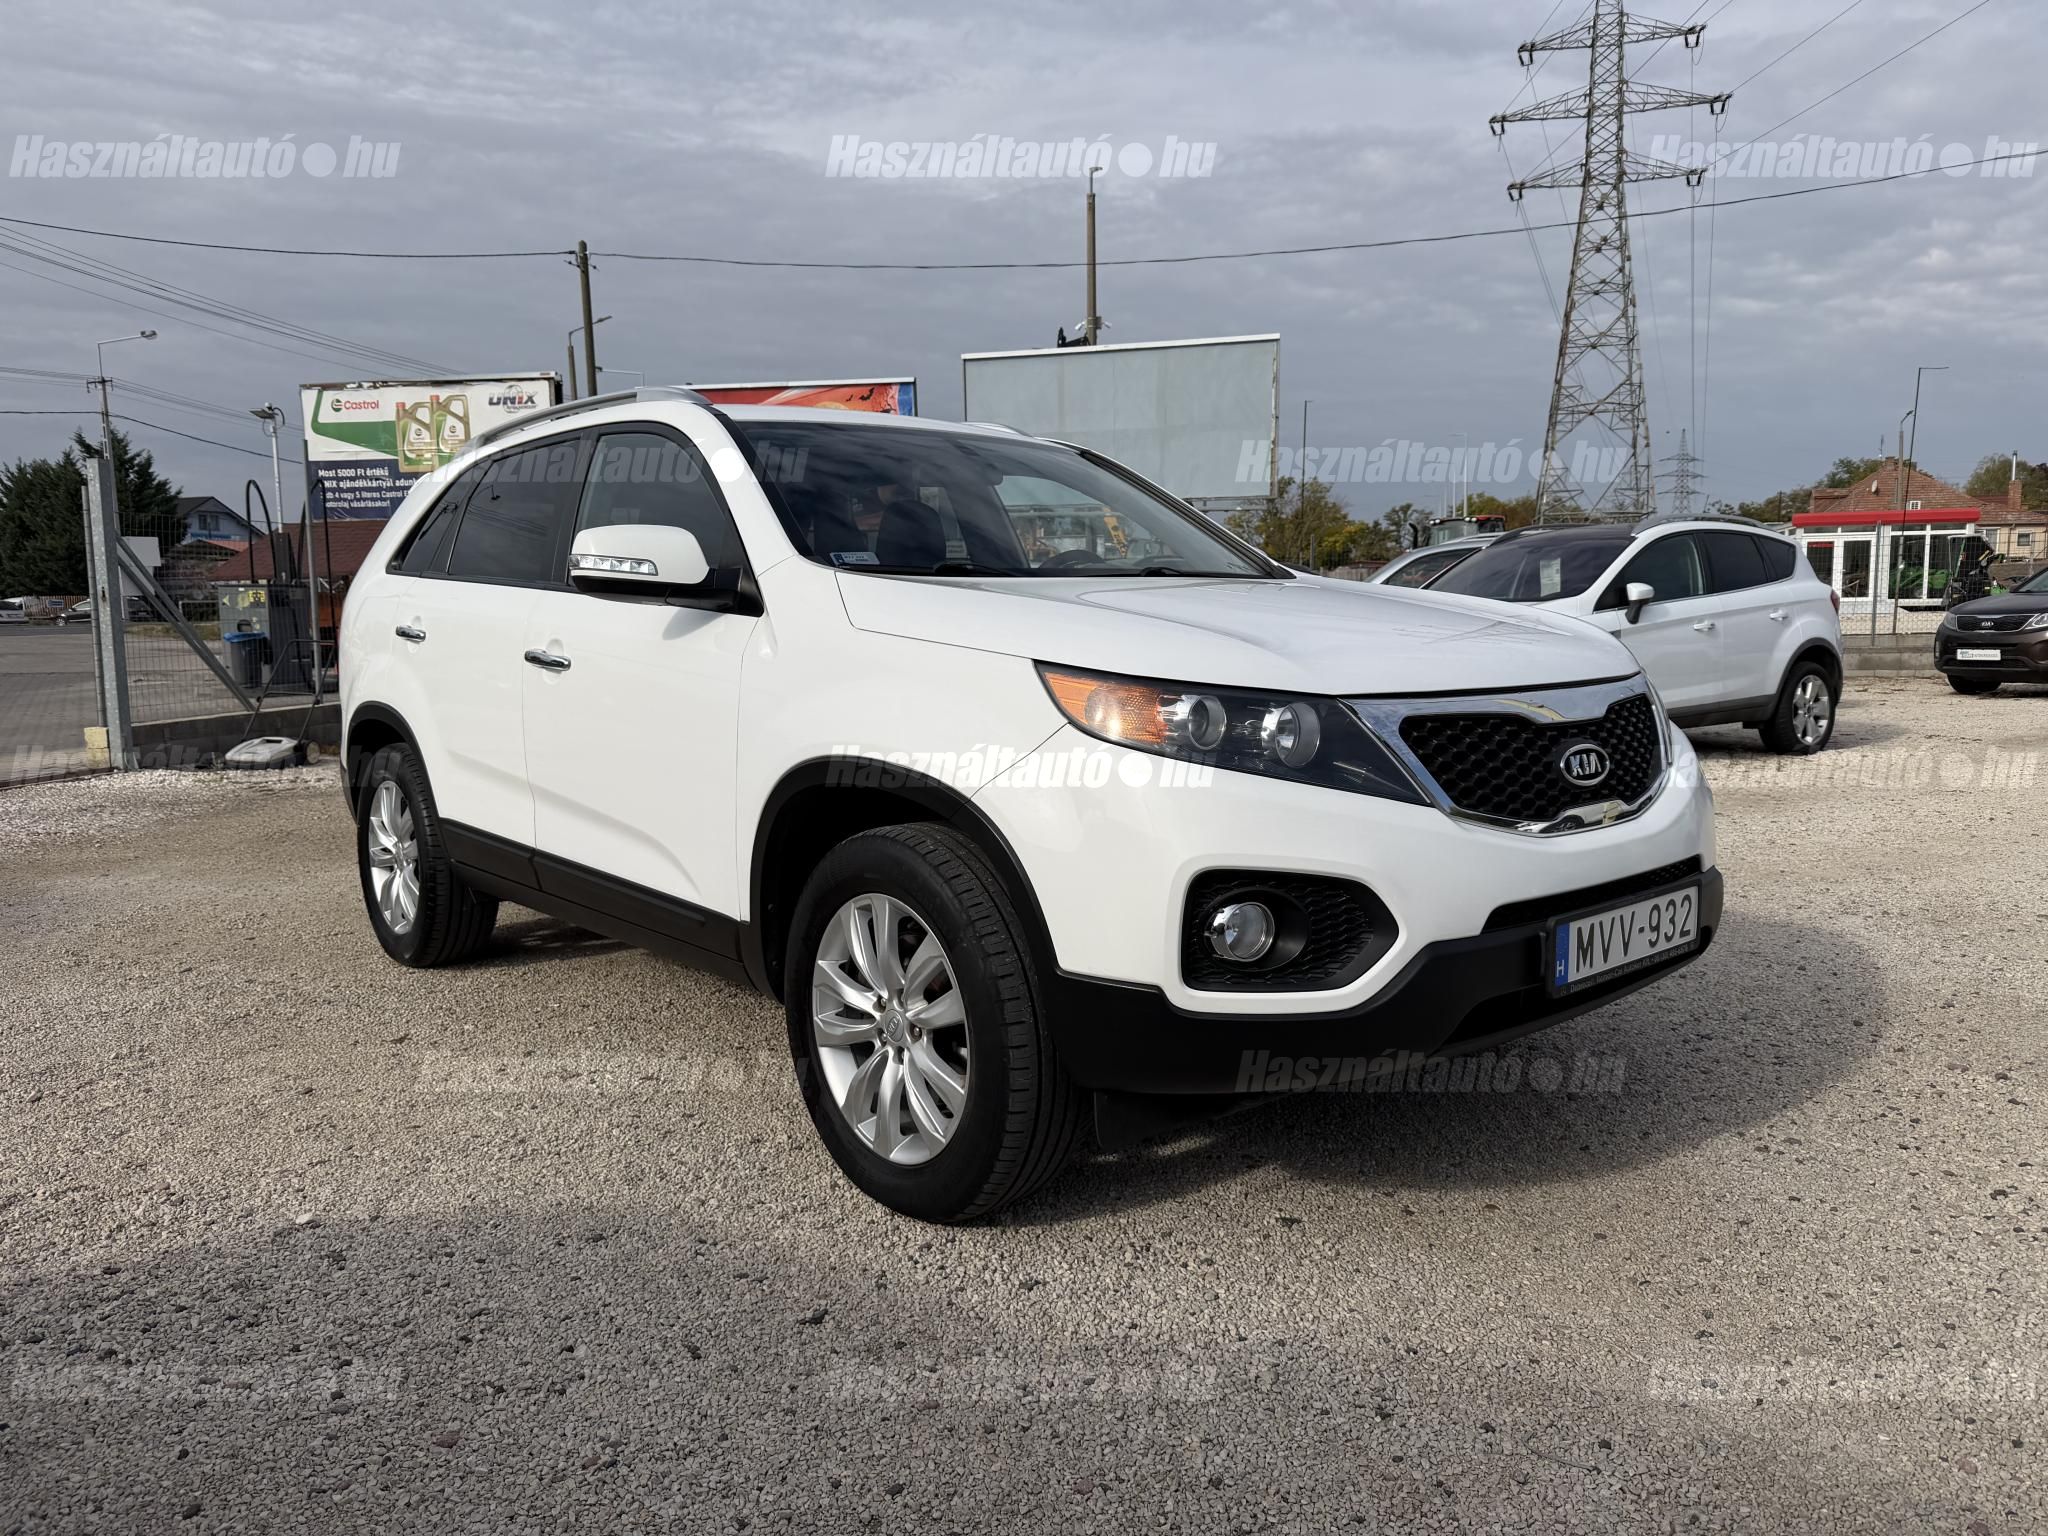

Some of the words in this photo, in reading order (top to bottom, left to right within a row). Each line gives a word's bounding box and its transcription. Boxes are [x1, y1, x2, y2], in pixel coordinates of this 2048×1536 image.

[489, 391, 537, 406] UNIX
[343, 400, 380, 410] Castrol
[318, 469, 336, 477] Most
[338, 468, 356, 476] 5000
[357, 468, 365, 476] Ft
[319, 480, 338, 488] NIX
[381, 490, 403, 498] Castrol
[1569, 752, 1602, 777] KIA
[1556, 959, 1565, 978] H
[1575, 893, 1693, 974] MVV-932
